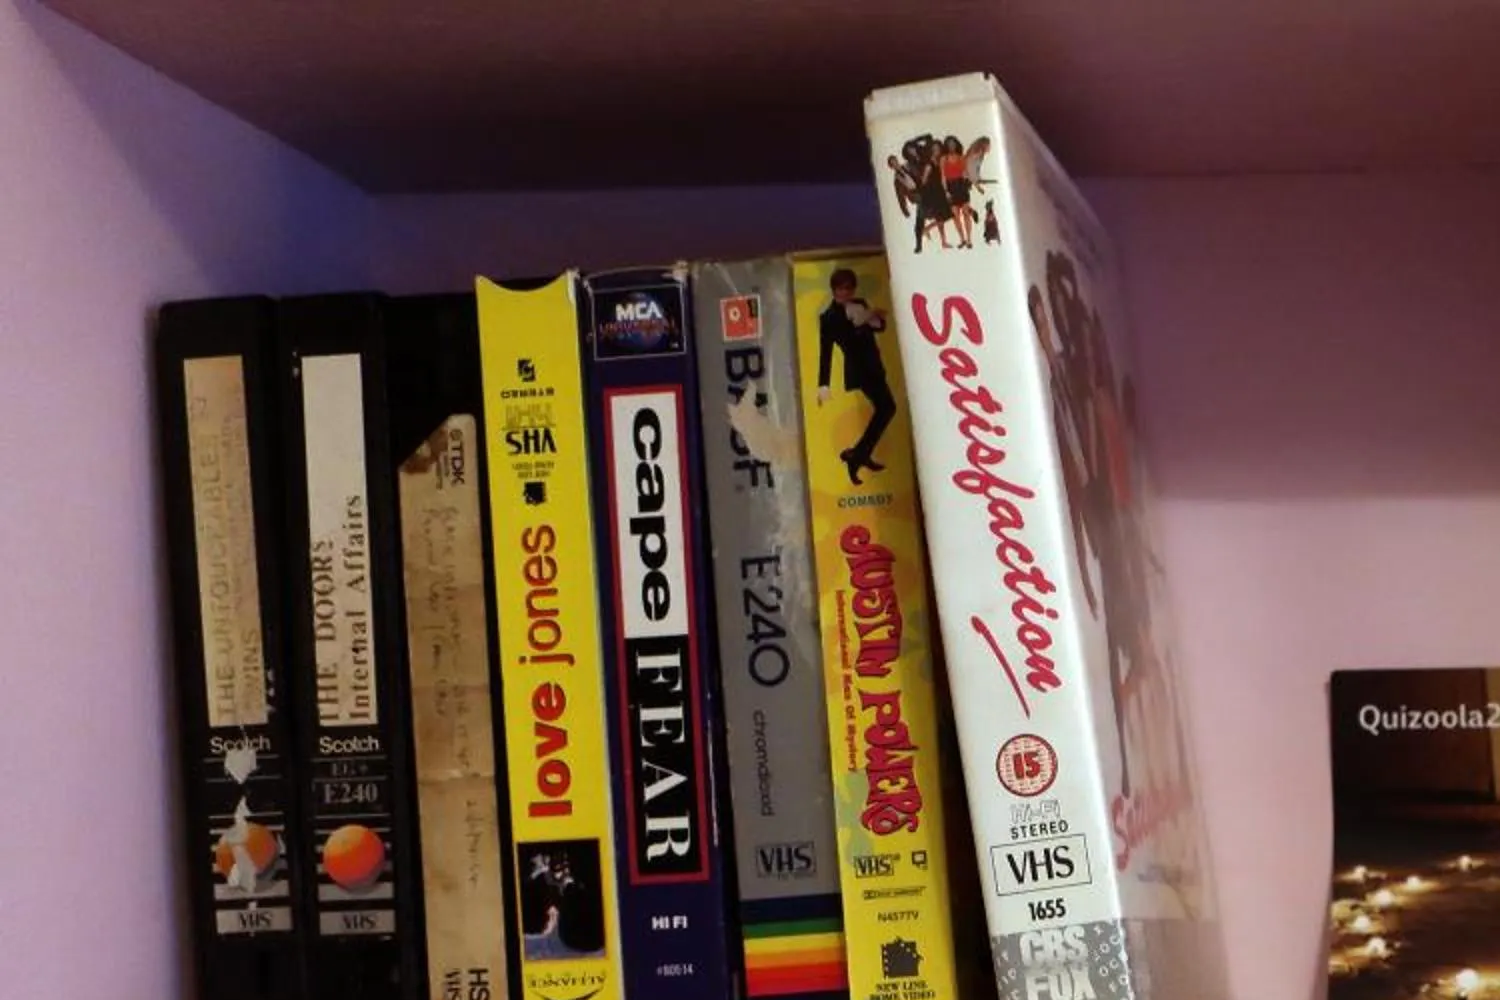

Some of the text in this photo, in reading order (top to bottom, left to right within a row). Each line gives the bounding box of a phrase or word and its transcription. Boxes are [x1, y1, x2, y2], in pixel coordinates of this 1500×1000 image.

[615, 301, 663, 321] MCA
[504, 428, 557, 455] VHS
[451, 440, 465, 486] TDK
[911, 292, 1063, 693] Satisfaction
[630, 407, 671, 621] cape
[339, 494, 372, 719] Internal Affairs
[518, 524, 576, 666] jones
[840, 524, 905, 679] AUSTIN
[316, 663, 341, 723] THE
[210, 735, 271, 753] Scotch
[319, 736, 380, 754] Scotch
[527, 681, 573, 818] love
[635, 647, 692, 861] FEAR
[857, 688, 924, 836] POWERS
[1012, 751, 1041, 780] 15
[323, 783, 379, 803] E240
[1011, 820, 1069, 840] STEREO
[758, 846, 812, 873] VHS
[855, 859, 891, 876] VHS
[1007, 845, 1075, 885] VHS
[651, 914, 688, 930] HI FI
[1027, 898, 1066, 921] 1655
[1019, 925, 1089, 966] CBS
